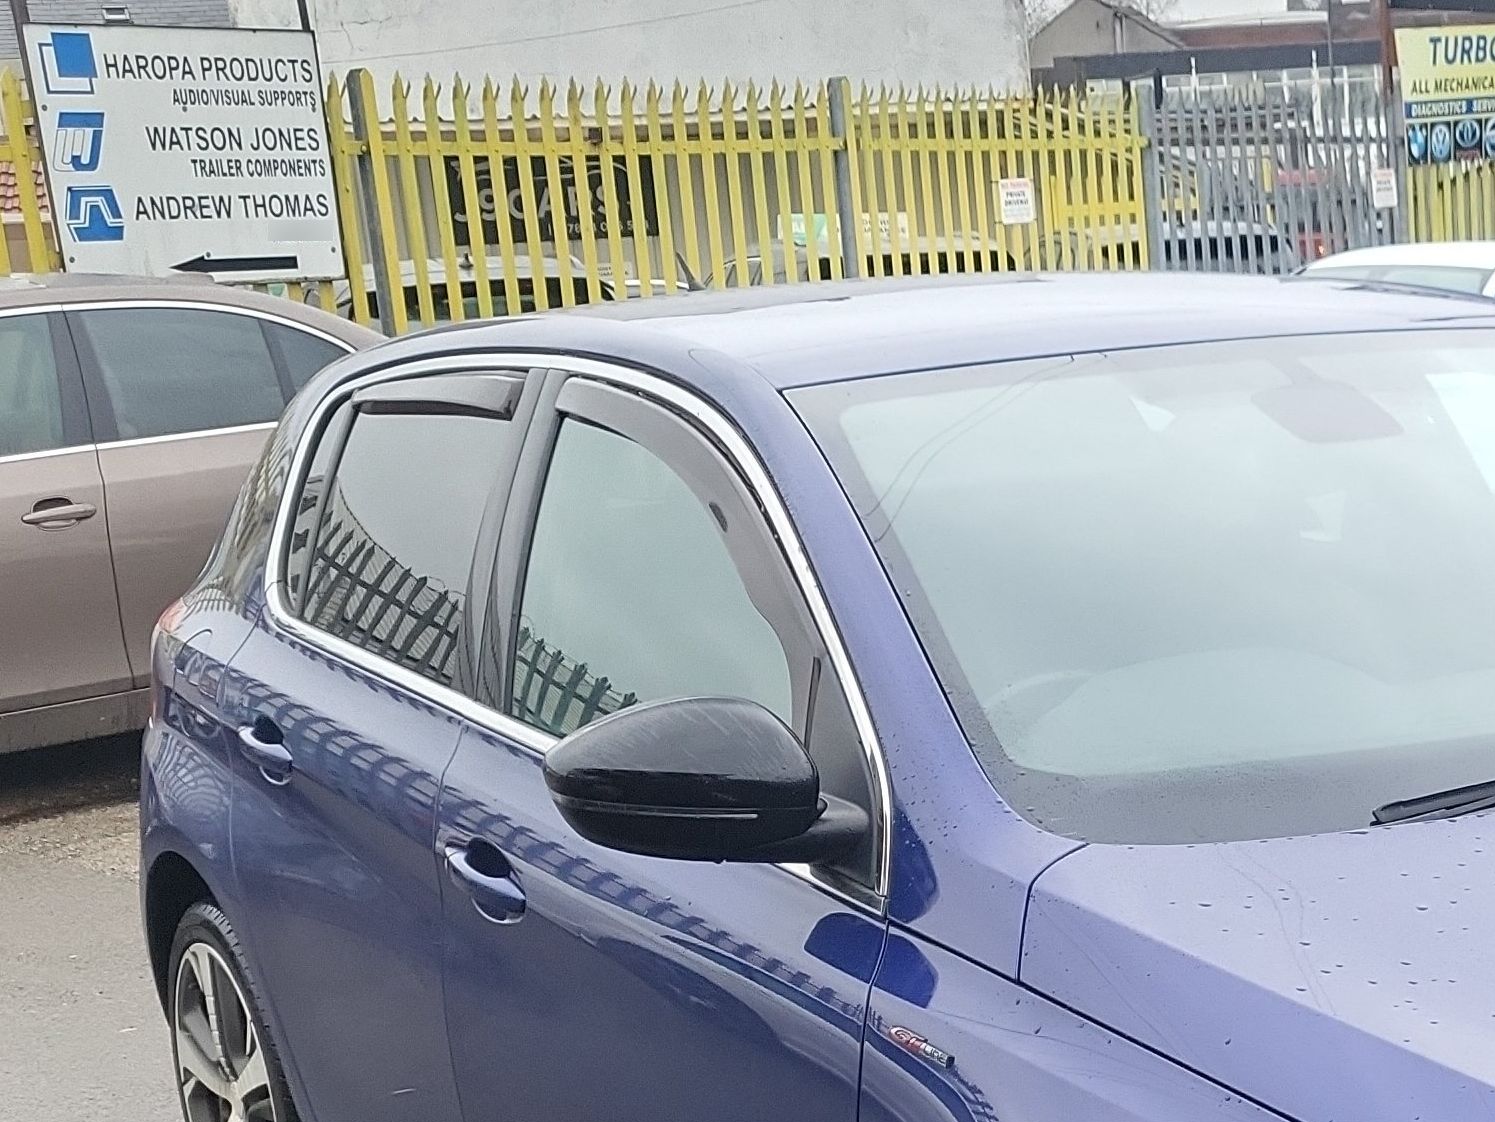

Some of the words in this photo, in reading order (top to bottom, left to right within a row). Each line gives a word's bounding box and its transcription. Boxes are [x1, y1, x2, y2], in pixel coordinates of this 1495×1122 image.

[104, 54, 196, 81] HAROPA
[200, 57, 313, 84] PRODUCTS
[1411, 79, 1431, 94] ALL
[257, 90, 317, 108] SUPPORTS
[1411, 102, 1467, 118] DIAGNOSTICS
[146, 126, 242, 152] WATSON
[250, 127, 321, 152] JONES
[191, 159, 244, 178] TRAILER
[247, 158, 326, 178] COMPONENTS
[135, 196, 233, 221] ANDREW
[240, 193, 330, 219] THOMAS
